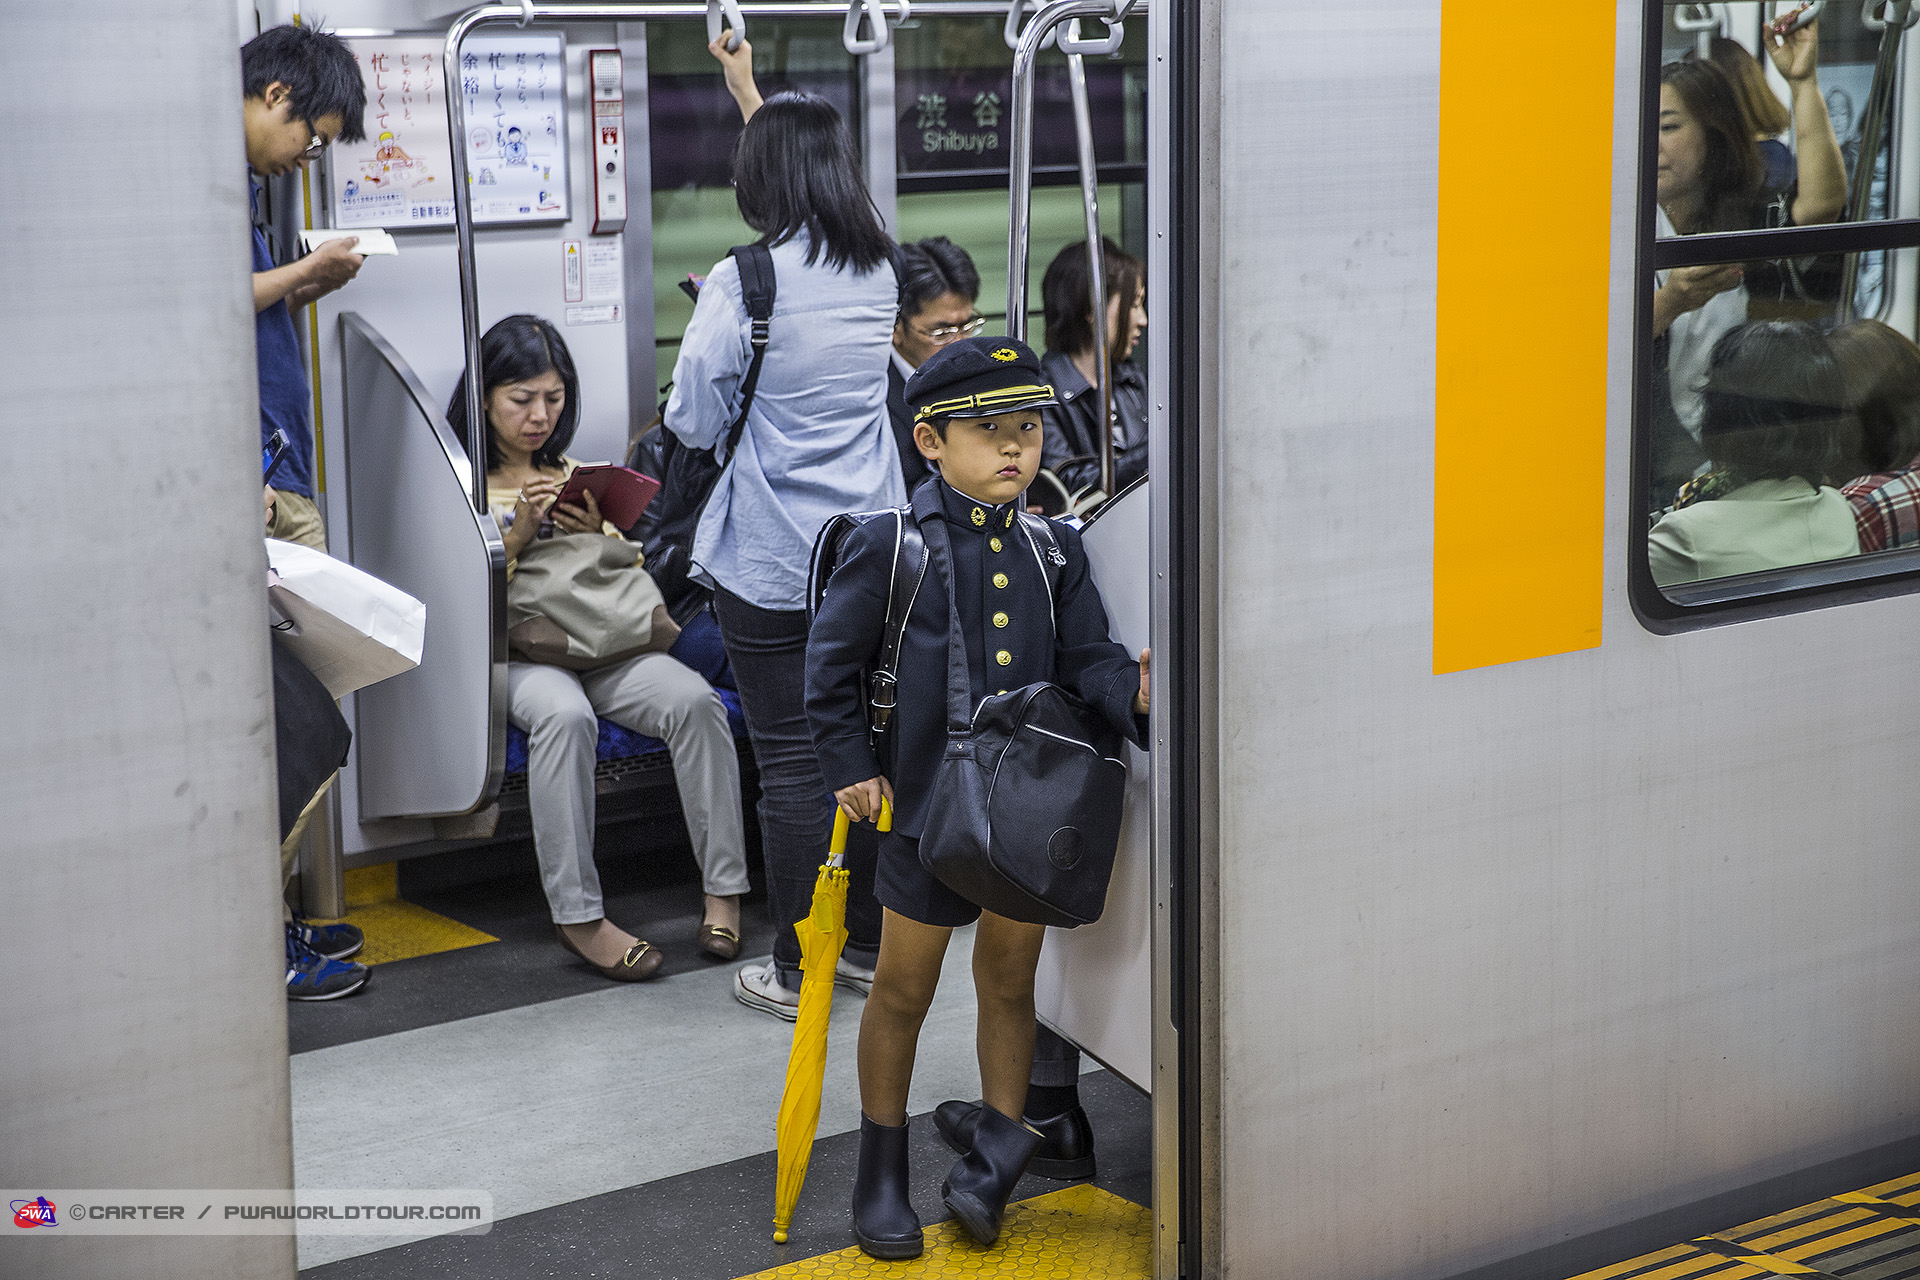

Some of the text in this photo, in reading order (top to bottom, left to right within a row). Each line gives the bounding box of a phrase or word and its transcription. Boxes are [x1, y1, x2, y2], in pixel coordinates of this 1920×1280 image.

[371, 52, 390, 129] 忙しくて
[922, 129, 999, 155] Shibuya
